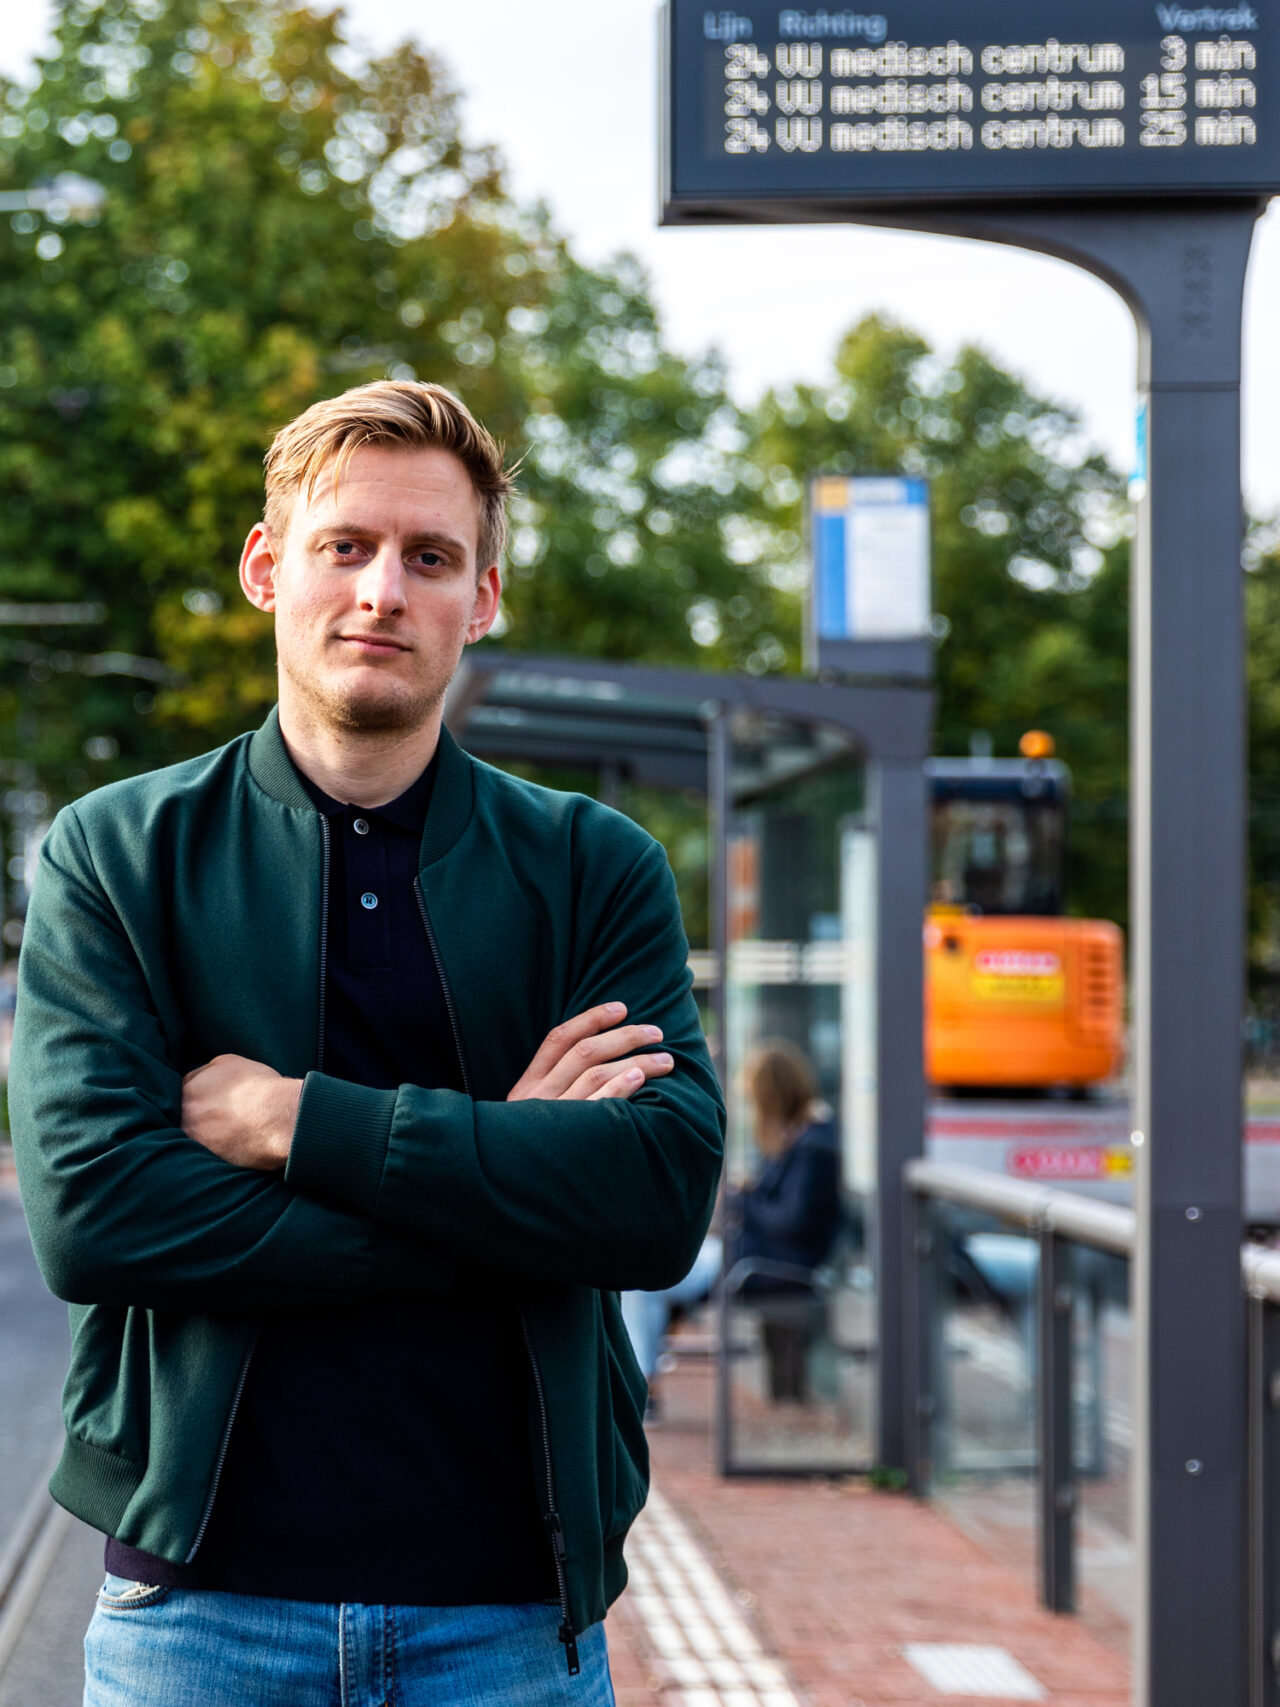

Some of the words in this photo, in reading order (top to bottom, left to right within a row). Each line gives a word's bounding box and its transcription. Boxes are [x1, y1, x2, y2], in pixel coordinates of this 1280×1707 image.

[704, 11, 752, 43] Lijn
[779, 10, 888, 43] Richting
[1157, 3, 1258, 32] Vertrek
[724, 44, 771, 79] 24
[776, 43, 822, 78] VU
[830, 40, 973, 77] medisch
[981, 38, 1125, 74] centrum
[1161, 36, 1187, 71] 3
[1195, 35, 1256, 70] min
[724, 81, 771, 117] 24
[776, 80, 822, 115] VU
[830, 76, 973, 114] medisch
[981, 73, 1125, 111] centrum
[1140, 72, 1187, 108] 15
[1195, 72, 1256, 108] min
[724, 116, 771, 154] 24
[776, 117, 822, 152] VU
[830, 113, 973, 151] medisch
[981, 110, 1125, 148] centrum
[1140, 110, 1187, 145] 25
[1195, 109, 1256, 145] min
